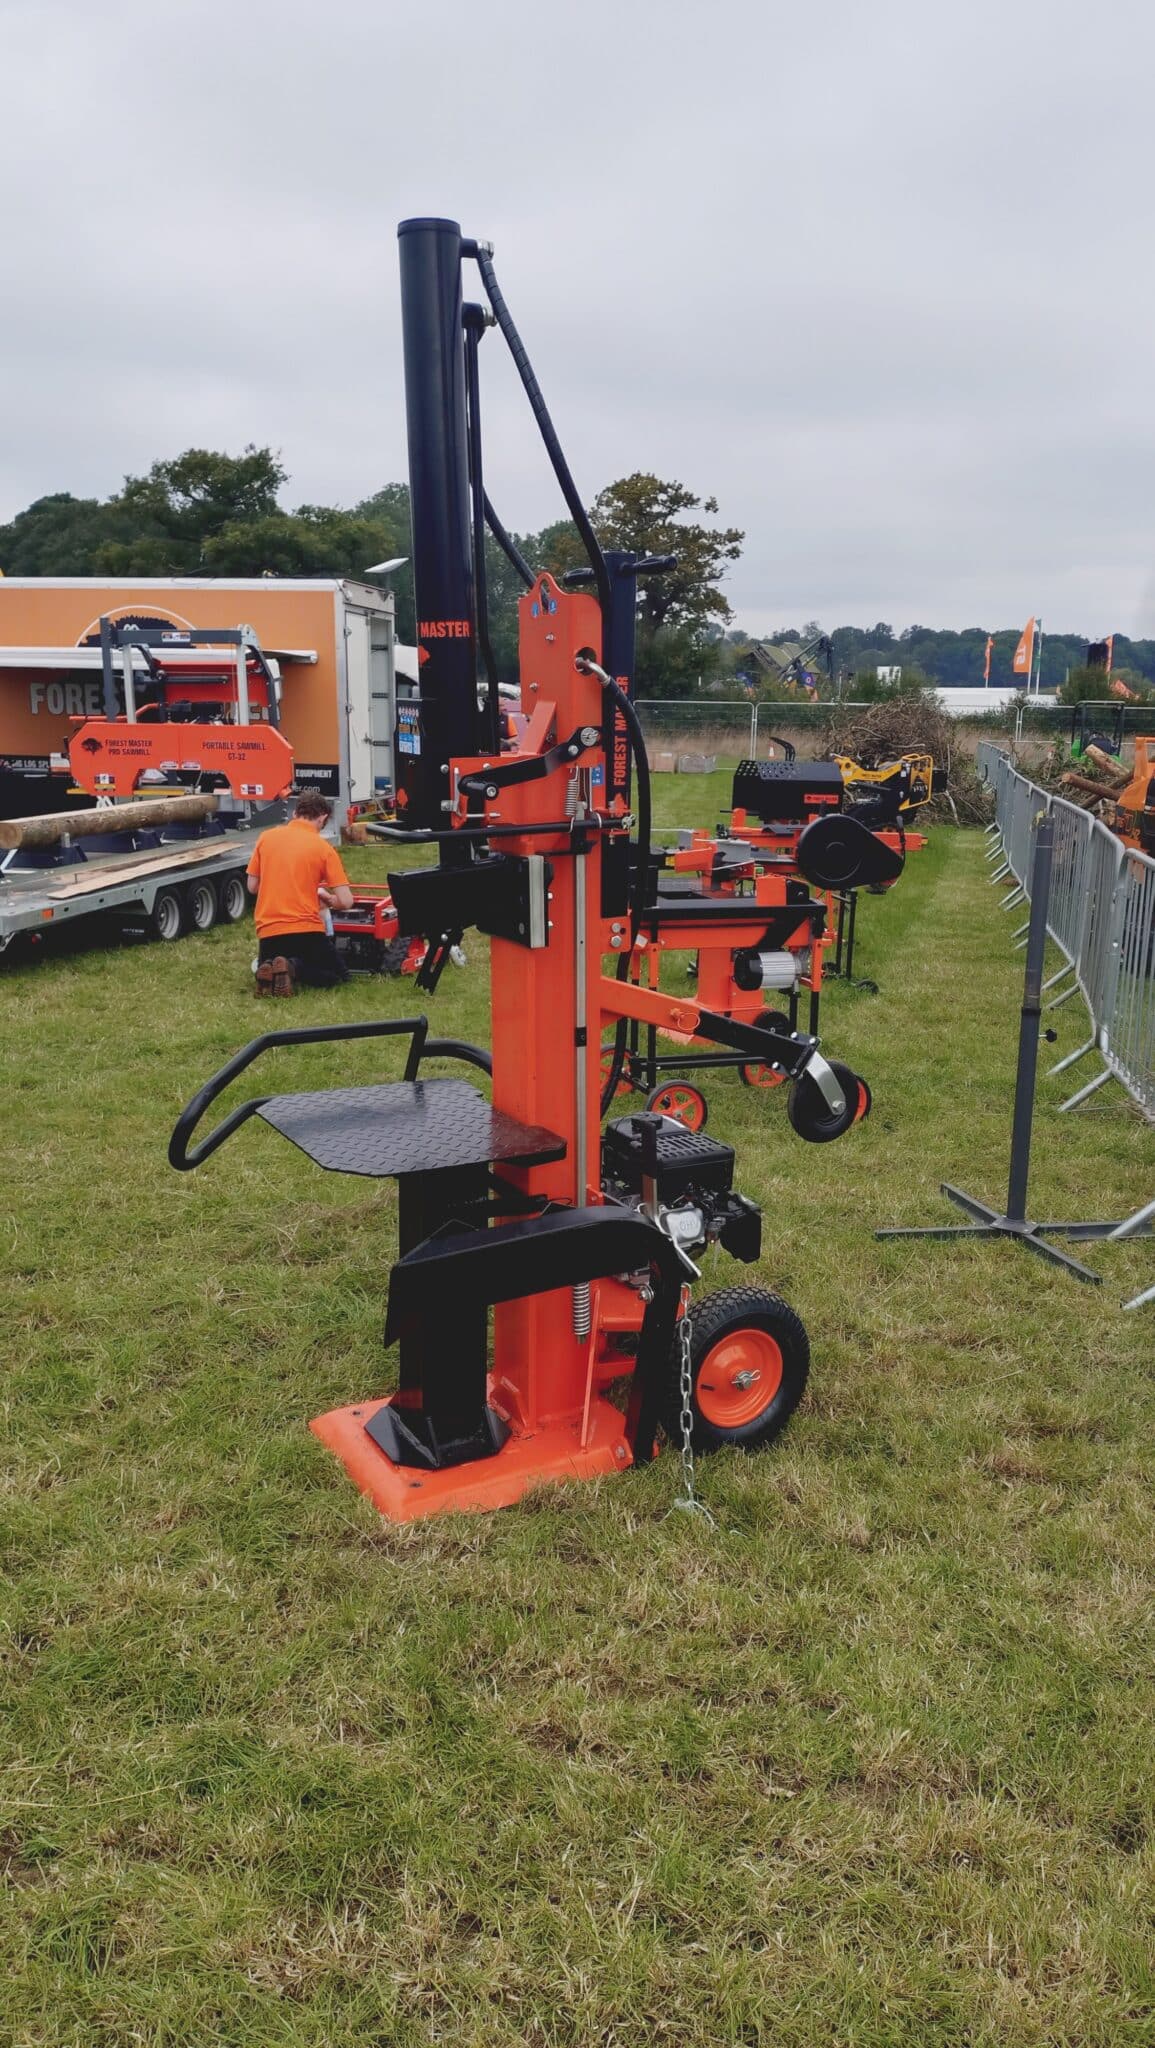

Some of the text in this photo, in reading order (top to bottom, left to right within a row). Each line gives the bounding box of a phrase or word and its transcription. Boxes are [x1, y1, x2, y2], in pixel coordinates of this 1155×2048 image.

[420, 620, 470, 638] MASTER
[29, 682, 122, 716] FORE
[104, 739, 153, 748] FOREST MASTER
[202, 741, 267, 751] PORTABLE SAWMILL
[108, 748, 151, 756] PRO SAWMILL
[613, 735, 627, 786] FOREST
[295, 769, 332, 778] EQUIPMENT
